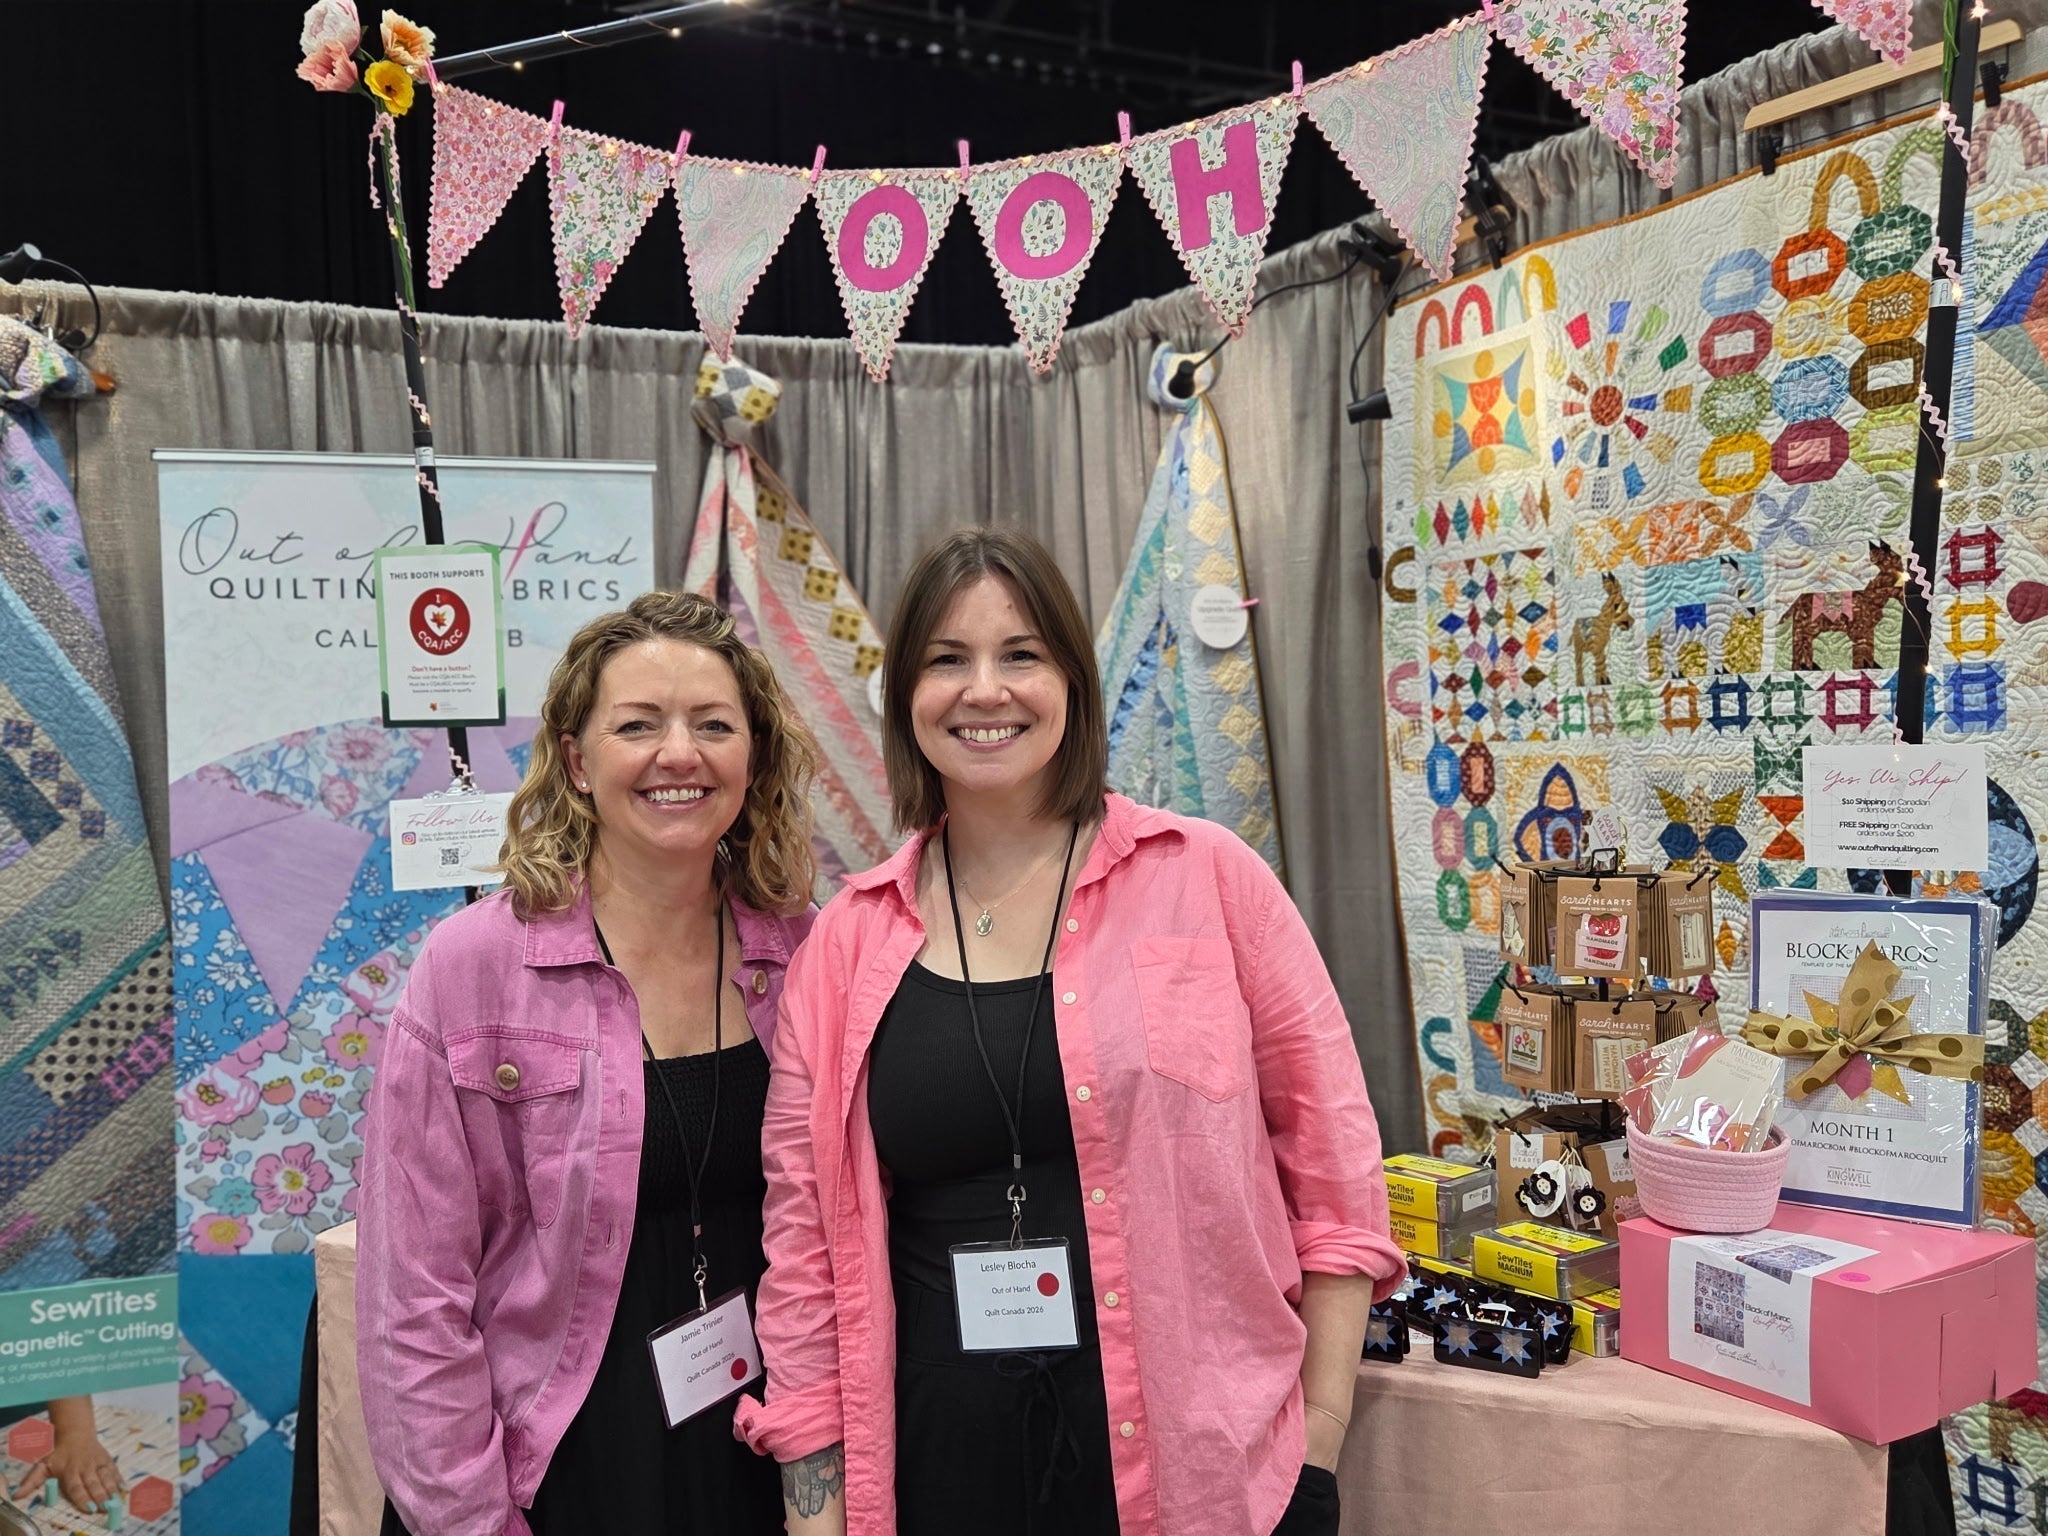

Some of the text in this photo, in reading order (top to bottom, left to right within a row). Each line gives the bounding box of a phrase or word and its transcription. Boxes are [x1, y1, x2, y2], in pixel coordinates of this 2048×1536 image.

[179, 507, 303, 576] Out
[453, 501, 637, 583] Hand
[390, 569, 485, 580] THIS BOOTH SUPPORTS
[209, 577, 620, 601] QUILTIN BRICS
[435, 594, 441, 604] I
[418, 628, 464, 651] CQA/ACC
[411, 665, 428, 673] Don't
[1869, 768, 1899, 785] We
[1908, 762, 1969, 799] Ship!
[1841, 798, 1855, 806] $10
[1855, 798, 1887, 807] Shipping
[1897, 798, 1931, 807] Canadian
[1896, 806, 1914, 815] $100
[406, 805, 500, 829] Follow Us
[1839, 822, 1858, 830] FREE
[1858, 822, 1890, 831] Shipping
[1900, 822, 1934, 831] Canadian
[1896, 830, 1915, 838] $200
[1838, 844, 1939, 855] www.outofhandquilting.com
[1560, 894, 1633, 906] sarah HEARTS
[1668, 894, 1709, 907] sarah HEARTS
[1586, 936, 1618, 946] HANDMADE
[1786, 942, 1849, 960] BLOCK
[1584, 957, 1617, 968] HANDMADE
[1503, 1005, 1523, 1018] sarah
[1522, 1011, 1549, 1022] HEARTS
[1579, 1017, 1651, 1031] sarah HEARTS
[1602, 1046, 1612, 1089] WITH LOVE
[1609, 1044, 1621, 1090] HANDMADE
[1810, 1120, 1894, 1142] MONTH 1
[1516, 1147, 1538, 1157] sarah
[1791, 1138, 1948, 1164] OFMAROCBOM #BLOCKOFMAROCQUILT
[1827, 1169, 1871, 1185] KINGWELL
[1388, 1192, 1415, 1204] AGNUM
[980, 1259, 1037, 1273] Lesley Blocha
[1497, 1251, 1532, 1269] SewTites
[1497, 1261, 1534, 1278] MAGNUM
[991, 1285, 1031, 1295] Out of Hand
[30, 1291, 157, 1325] SewTites
[985, 1306, 1044, 1317] Quilt Canada 2026
[1745, 1303, 1791, 1324] Block of Maroc
[681, 1315, 724, 1344] Jamie Trinier
[0, 1321, 175, 1358] agnetic™ Cutting
[690, 1337, 724, 1361] Out of Hand
[686, 1352, 736, 1384] Quilt Canada 2026
